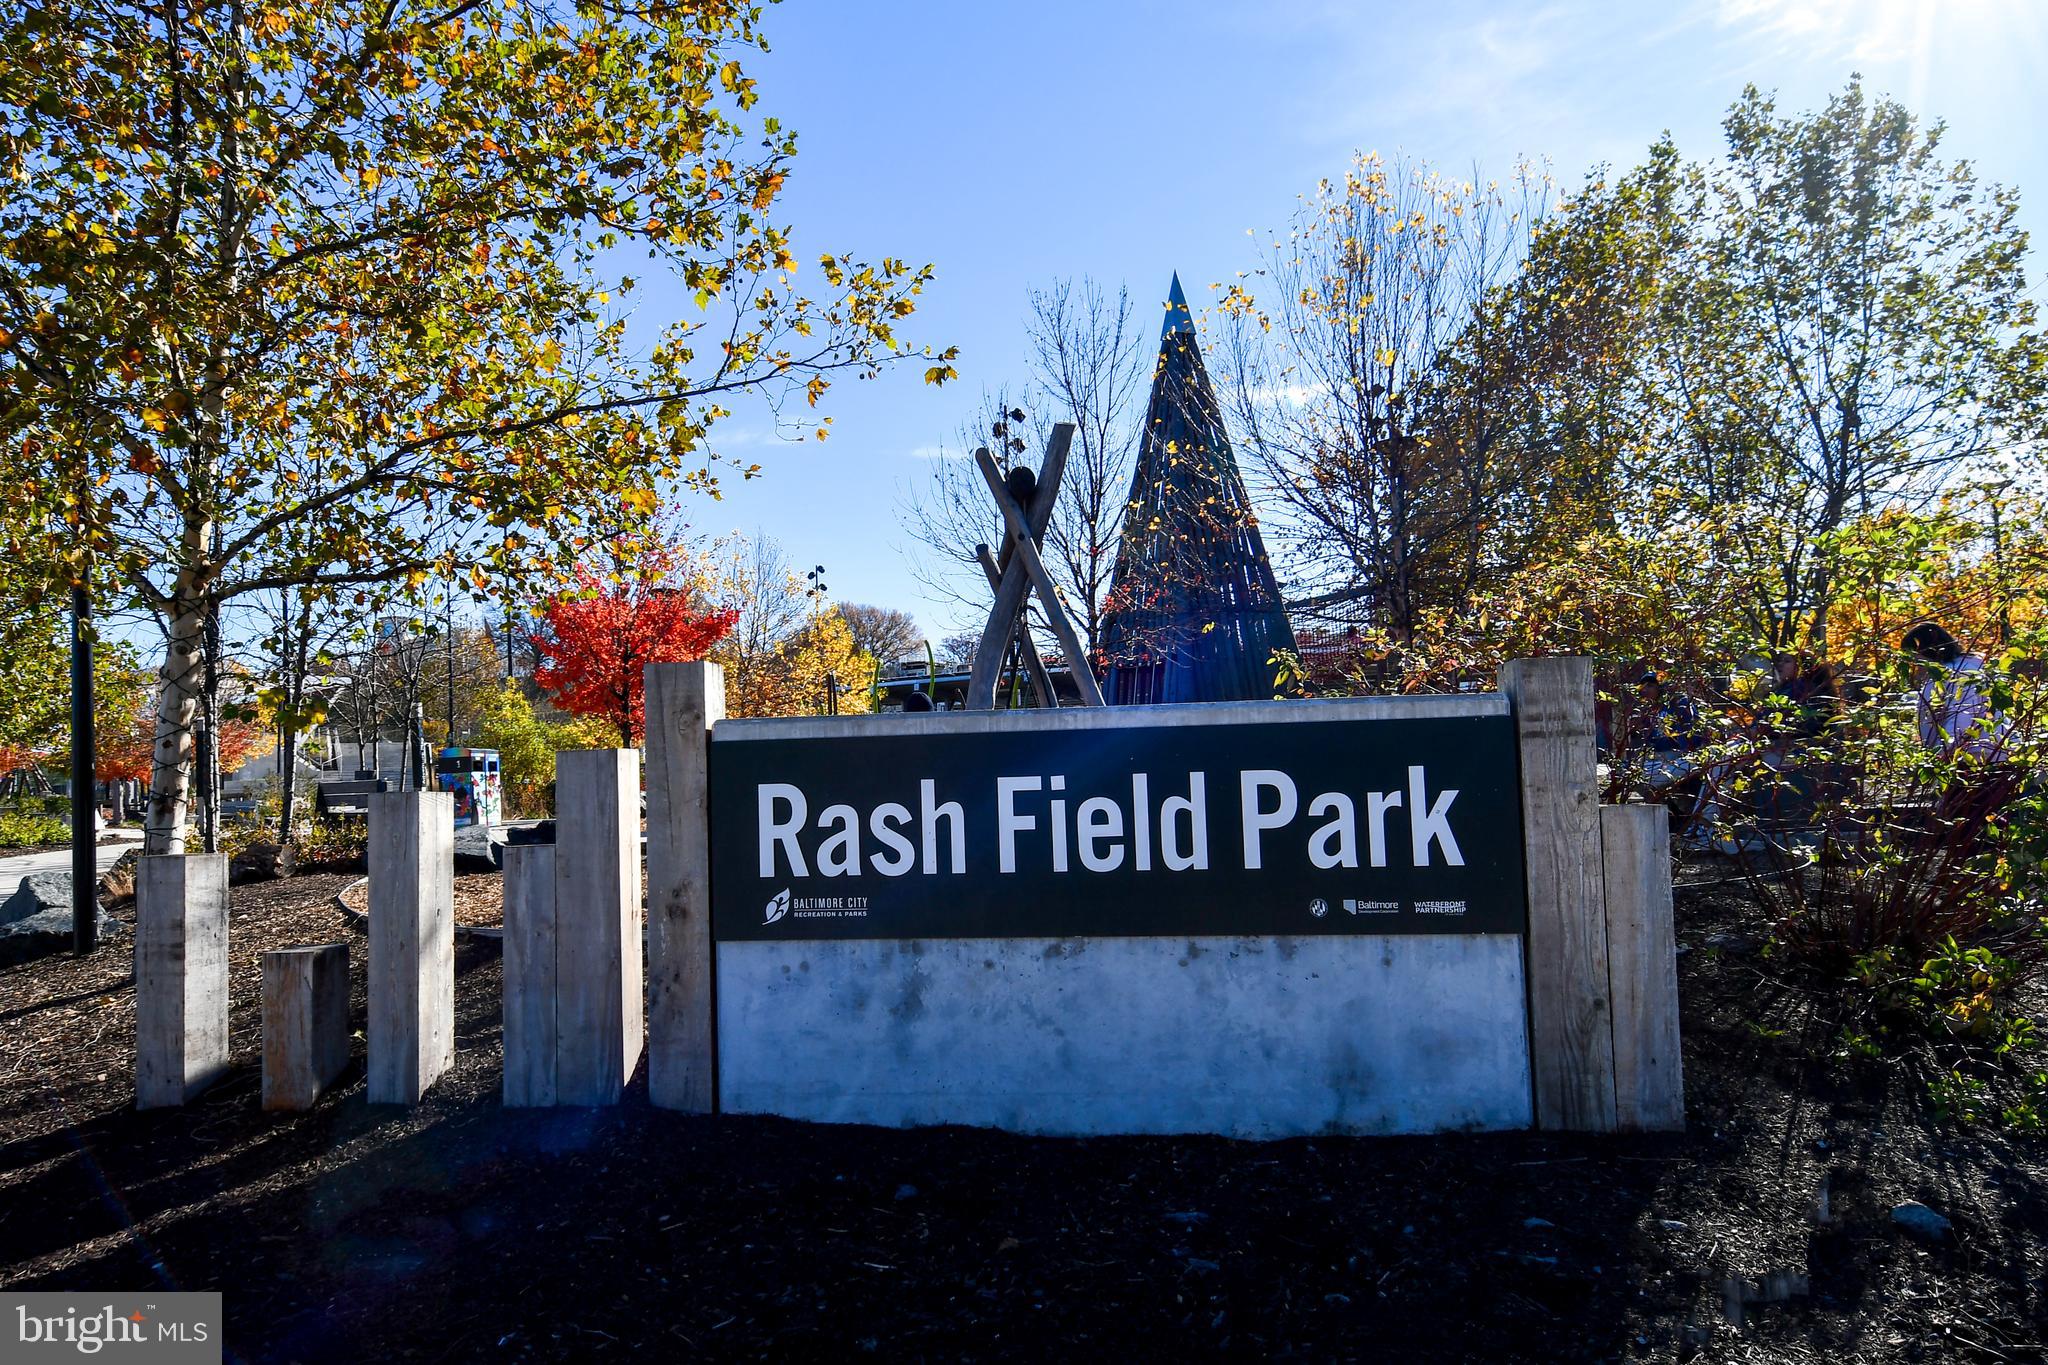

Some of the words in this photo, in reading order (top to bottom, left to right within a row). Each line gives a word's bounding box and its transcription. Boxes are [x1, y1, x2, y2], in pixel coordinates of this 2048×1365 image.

[758, 779, 966, 877] Rash
[998, 772, 1209, 874] Field
[1241, 766, 1466, 870] Park
[793, 897, 843, 909] BALTIMORE
[848, 897, 868, 908] CITY
[1358, 900, 1399, 909] Baltimore
